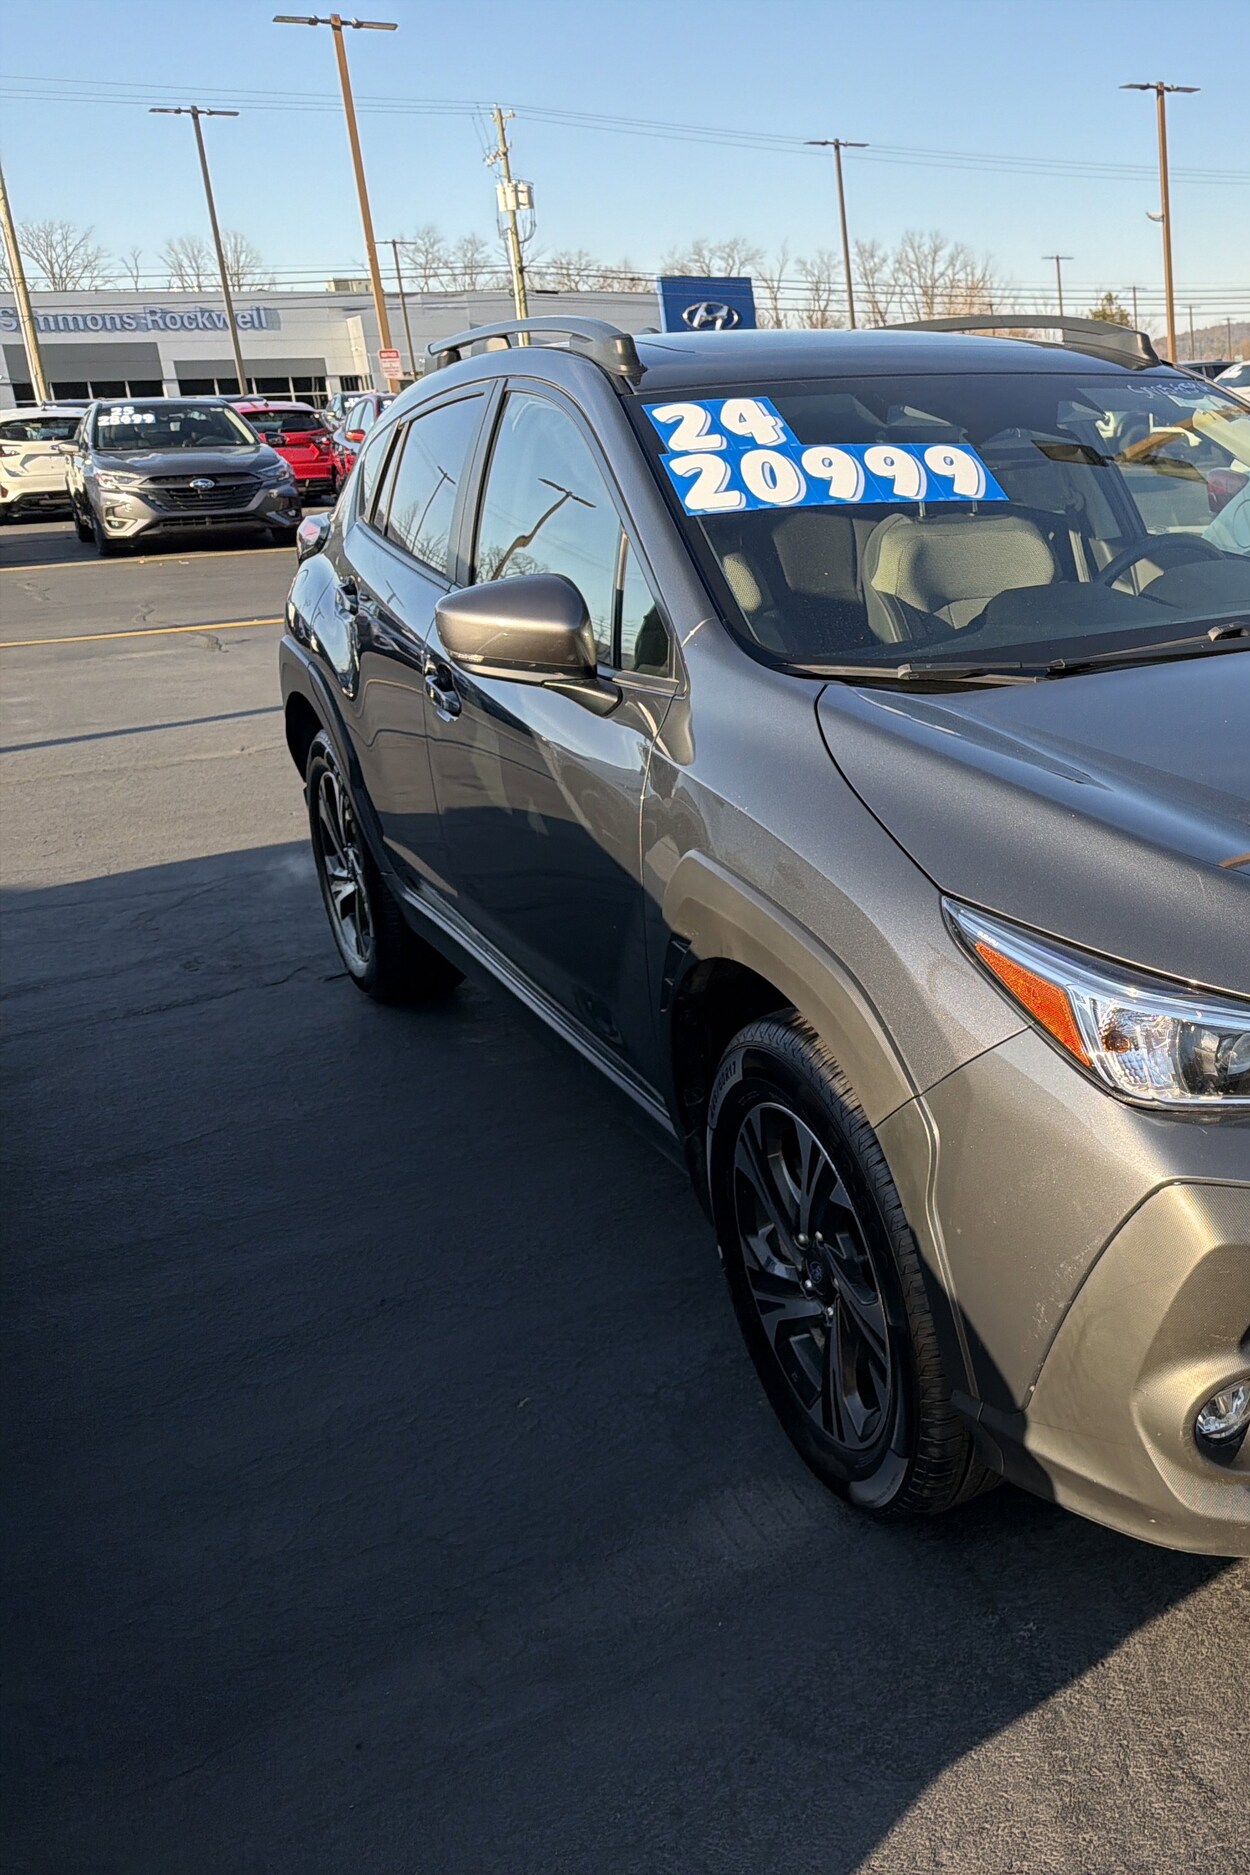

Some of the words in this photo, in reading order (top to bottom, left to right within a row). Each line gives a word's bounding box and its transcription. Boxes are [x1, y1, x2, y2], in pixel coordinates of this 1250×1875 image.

[110, 406, 135, 416] 25
[651, 398, 787, 453] 24
[668, 445, 987, 512] 20999
